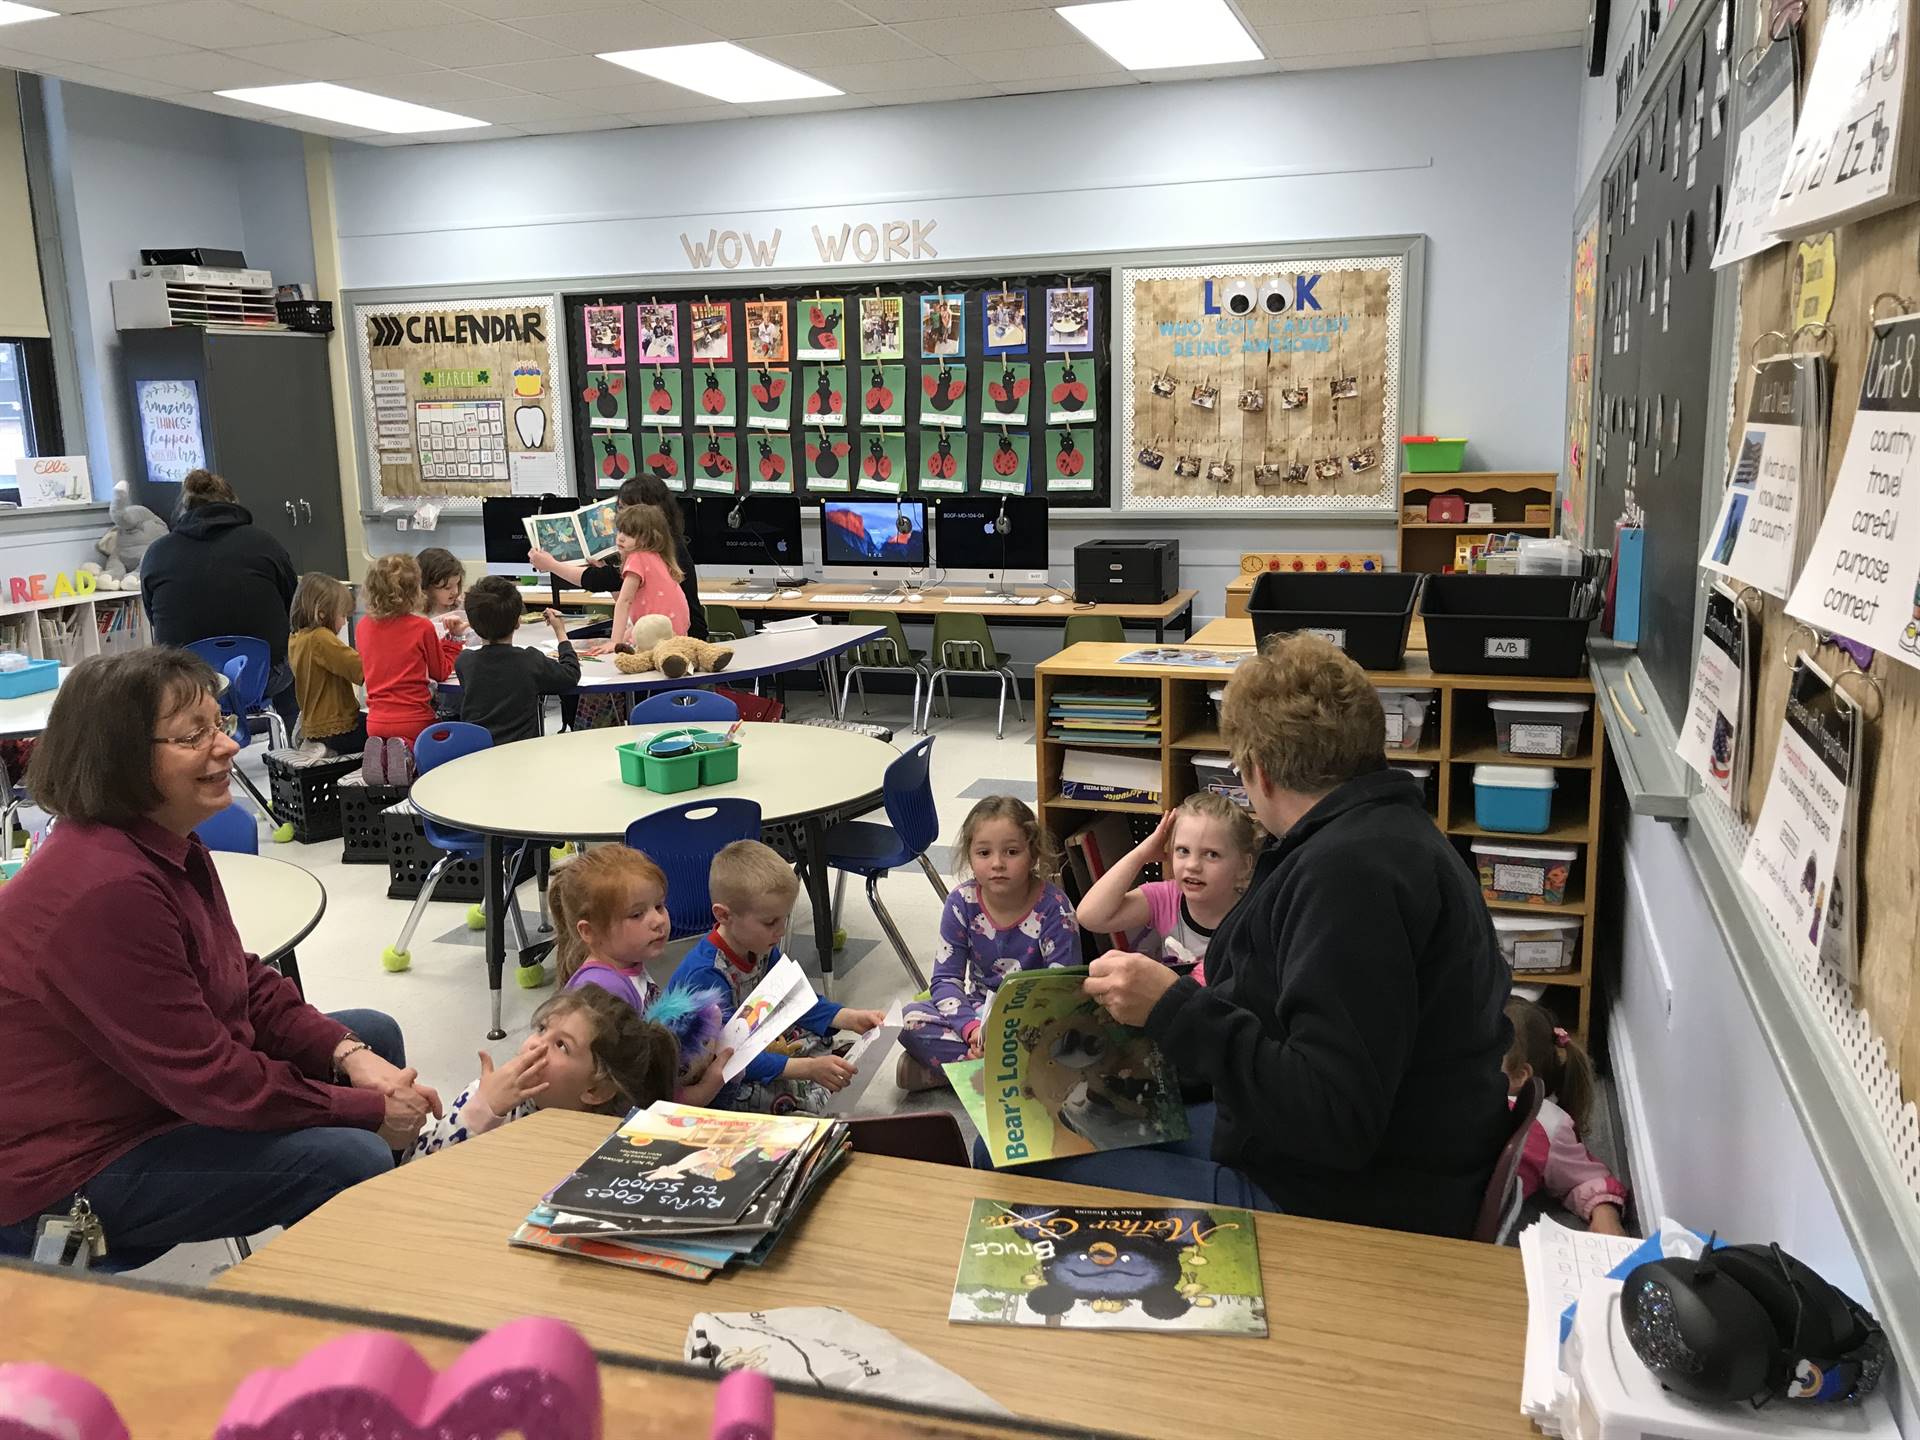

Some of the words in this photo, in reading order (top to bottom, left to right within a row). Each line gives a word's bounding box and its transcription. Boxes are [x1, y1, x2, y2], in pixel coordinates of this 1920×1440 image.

[679, 228, 782, 269] WOW
[811, 219, 938, 263] WORK
[406, 313, 546, 345] CALENDAR
[1159, 322, 1203, 337] WHO
[1215, 320, 1257, 335] GOT
[1269, 318, 1349, 334] CAUGHT
[1173, 340, 1231, 356] BEING
[438, 371, 474, 386] MARCH
[1866, 337, 1901, 398] Unit
[1901, 334, 1916, 398] 8
[144, 400, 193, 415] Amazing
[1870, 427, 1917, 463] country
[34, 460, 70, 474] Ellie
[1867, 465, 1902, 498] travel
[1852, 508, 1898, 542] careful
[1833, 549, 1890, 584] purpose
[10, 570, 97, 604] READ
[1823, 586, 1880, 625] connect
[1495, 642, 1518, 653] A/B
[996, 1018, 1021, 1082] Loose
[998, 1086, 1029, 1160] Bear's
[585, 1186, 645, 1205] Goes
[608, 1176, 684, 1194] School
[692, 1184, 717, 1196] to
[659, 1194, 725, 1211] Rufus
[1089, 1217, 1240, 1248] Mother
